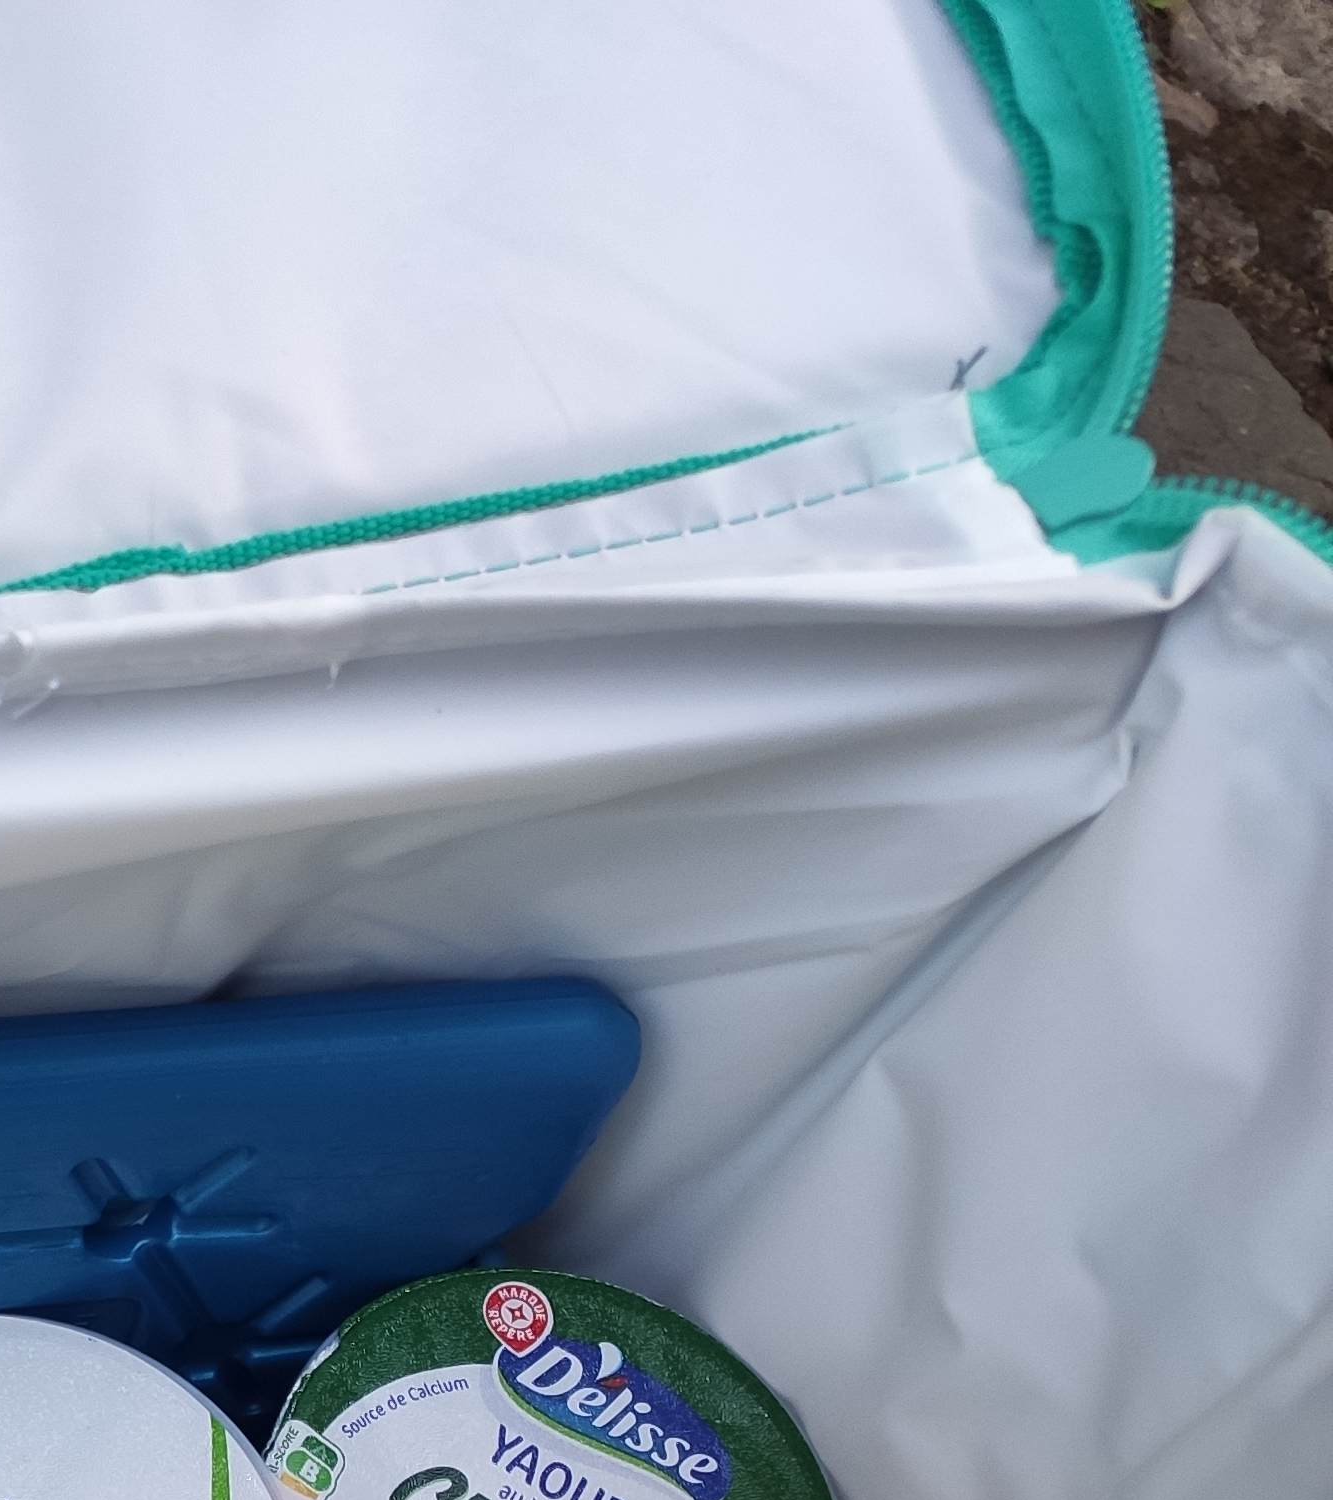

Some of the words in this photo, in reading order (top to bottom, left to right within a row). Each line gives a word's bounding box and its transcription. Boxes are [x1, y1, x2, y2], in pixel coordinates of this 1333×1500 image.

[498, 1288, 546, 1322] MARQUE
[341, 1404, 386, 1438] Source
[387, 1395, 407, 1411] de
[408, 1377, 470, 1402] Calcium
